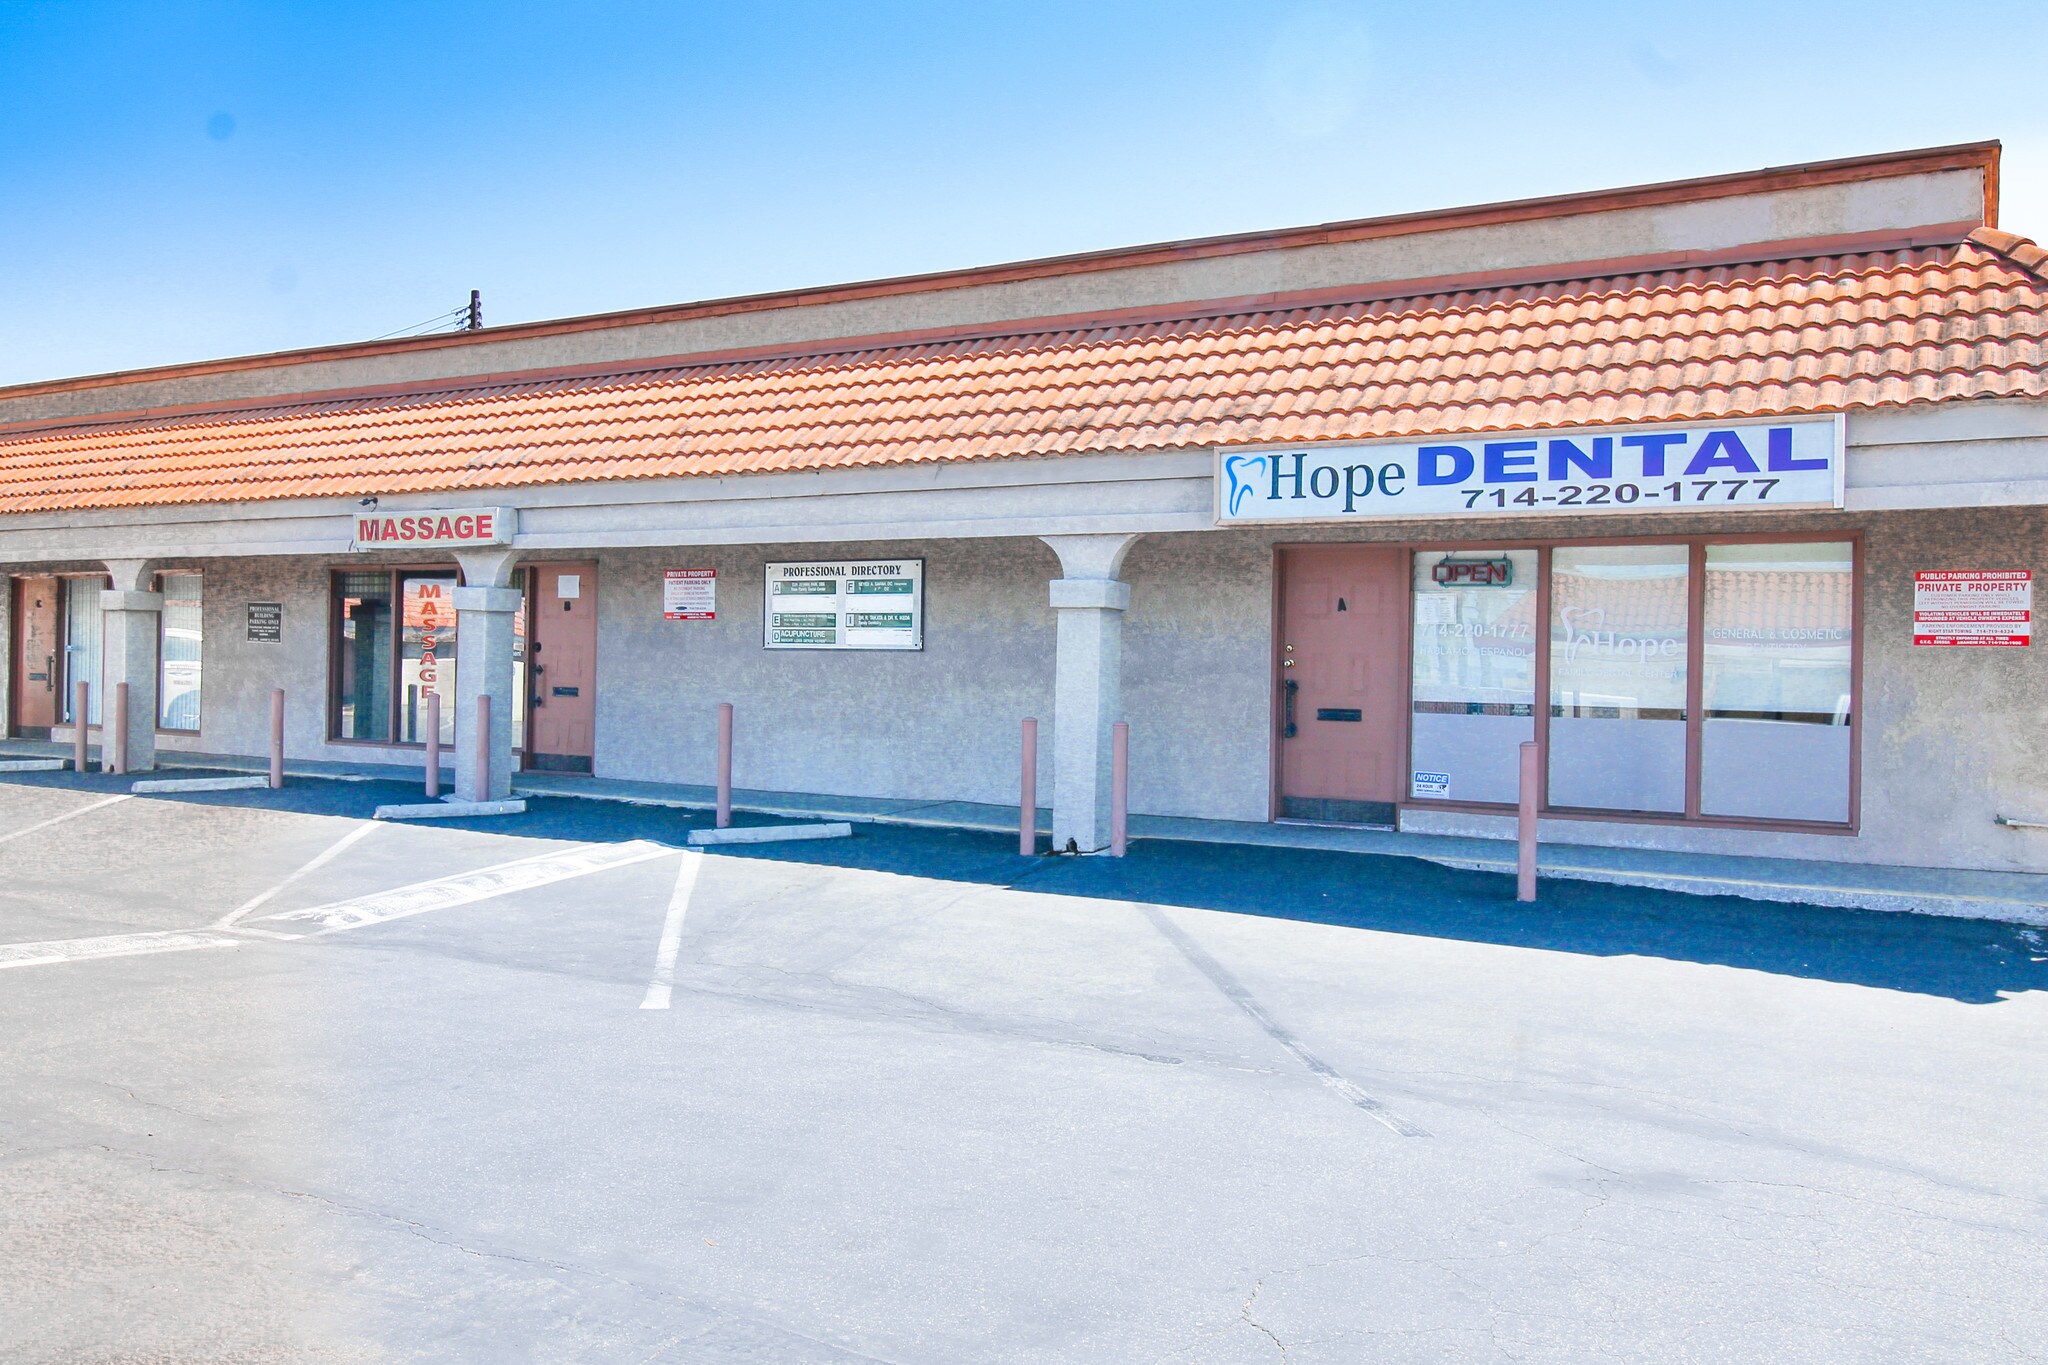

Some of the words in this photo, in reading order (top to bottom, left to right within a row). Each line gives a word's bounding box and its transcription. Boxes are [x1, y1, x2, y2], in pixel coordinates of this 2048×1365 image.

[1267, 453, 1406, 512] Hope
[1417, 427, 1828, 486] DENTAL
[1461, 479, 1780, 508] 714-220-1777
[359, 515, 493, 542] MASSAGE
[783, 566, 846, 577] PROFESSIONAL
[851, 565, 902, 576] DIRECTORY
[1432, 563, 1506, 582] OPEN
[1947, 572, 1980, 580] PARKING
[1981, 571, 2027, 579] PROHIBITED
[774, 584, 780, 592] A
[1917, 583, 1962, 592] PRIVATE
[1968, 582, 2027, 592] PROPERTY
[1337, 597, 1347, 612] A
[774, 615, 780, 624] E
[780, 630, 826, 638] ACUPUNCTURE
[1422, 623, 1529, 638] 714-220-1777
[1712, 627, 1764, 639] GENERAL
[1769, 629, 1776, 639] &
[1782, 628, 1843, 640] COSMETIC
[419, 584, 441, 699] MASSAGE
[1592, 630, 1678, 664] Hope
[1416, 773, 1448, 783] NOTICE
